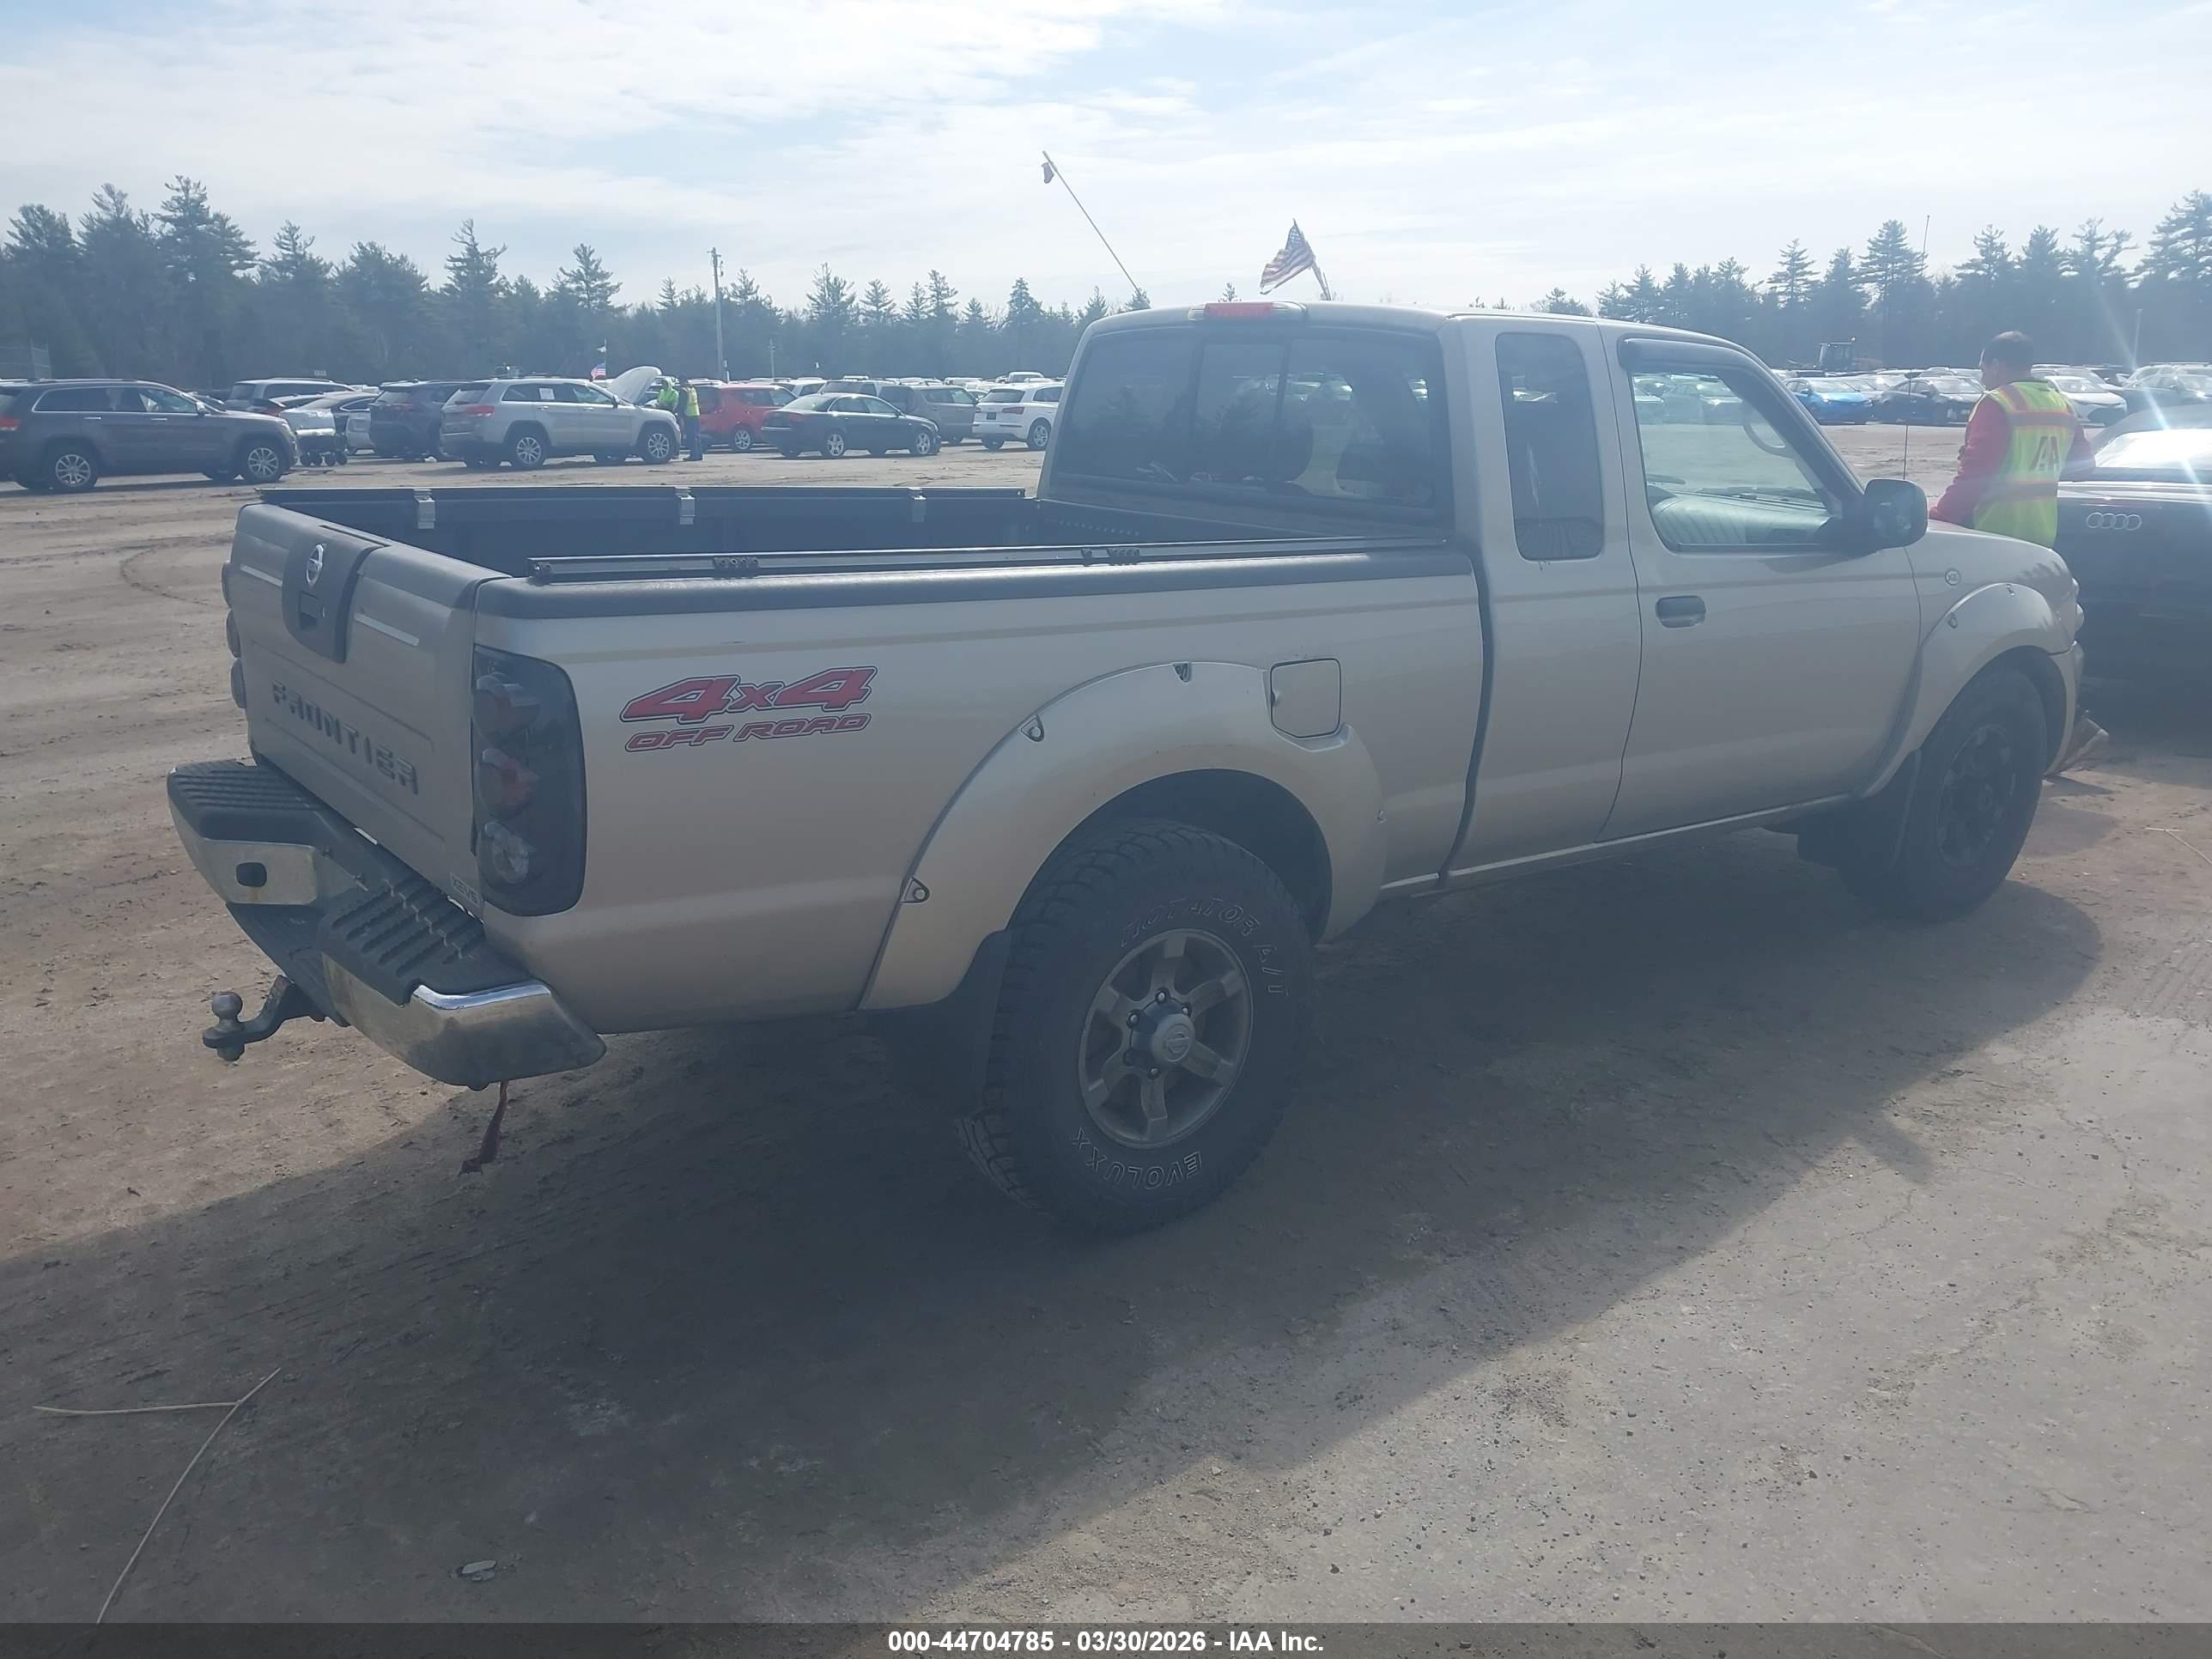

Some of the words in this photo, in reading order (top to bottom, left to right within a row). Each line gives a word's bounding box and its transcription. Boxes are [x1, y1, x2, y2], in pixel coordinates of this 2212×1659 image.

[619, 665, 878, 726] 4x4
[270, 679, 419, 795] FRONTIER
[624, 724, 734, 753] OFF
[732, 713, 872, 742] ROAD
[1071, 1126, 1202, 1191] EVOLUXX
